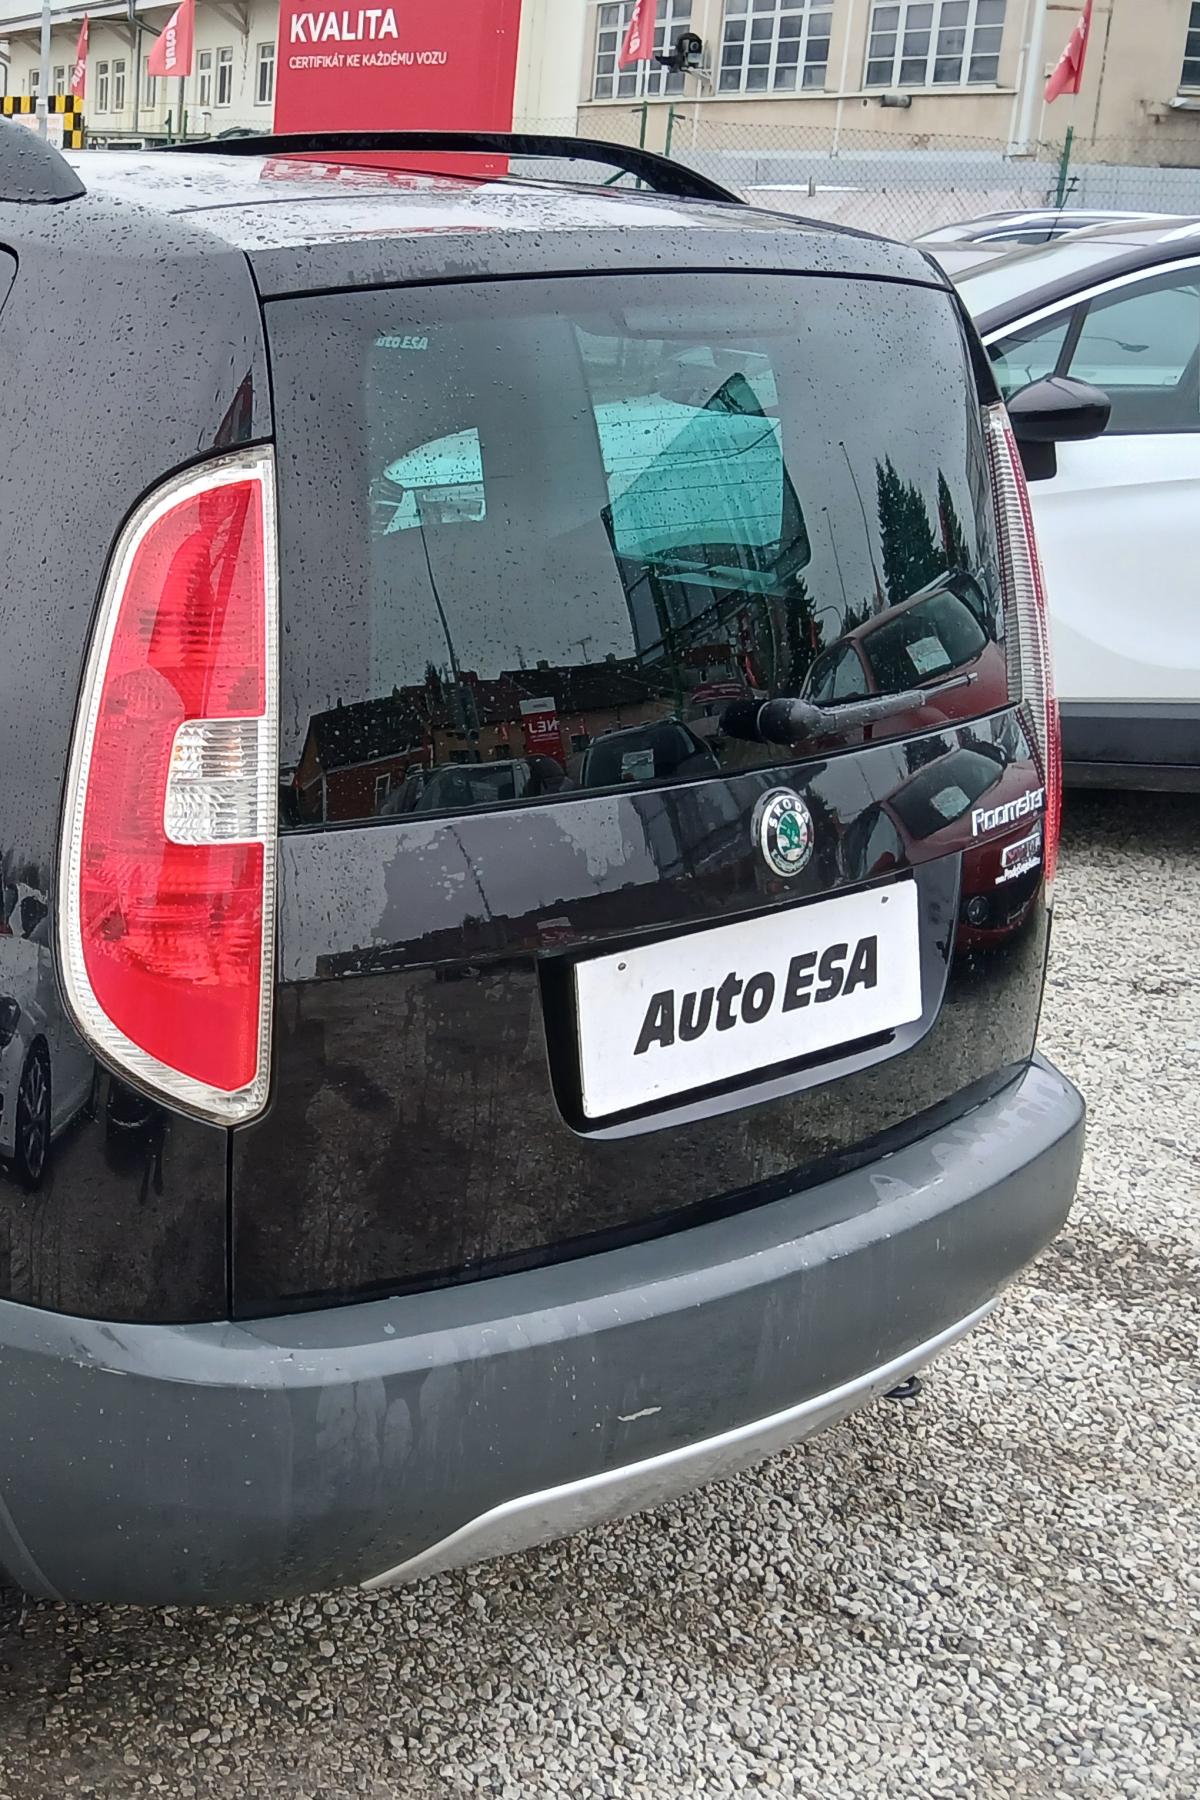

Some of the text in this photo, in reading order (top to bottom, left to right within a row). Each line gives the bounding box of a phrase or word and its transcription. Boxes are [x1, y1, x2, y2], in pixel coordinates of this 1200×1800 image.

[290, 8, 399, 43] KVALITA
[289, 50, 447, 69] CERTIFIKÁT KE KAŽDÉMU VOZU
[972, 788, 1044, 836] Roomster
[633, 935, 878, 1055] Auto ESA
